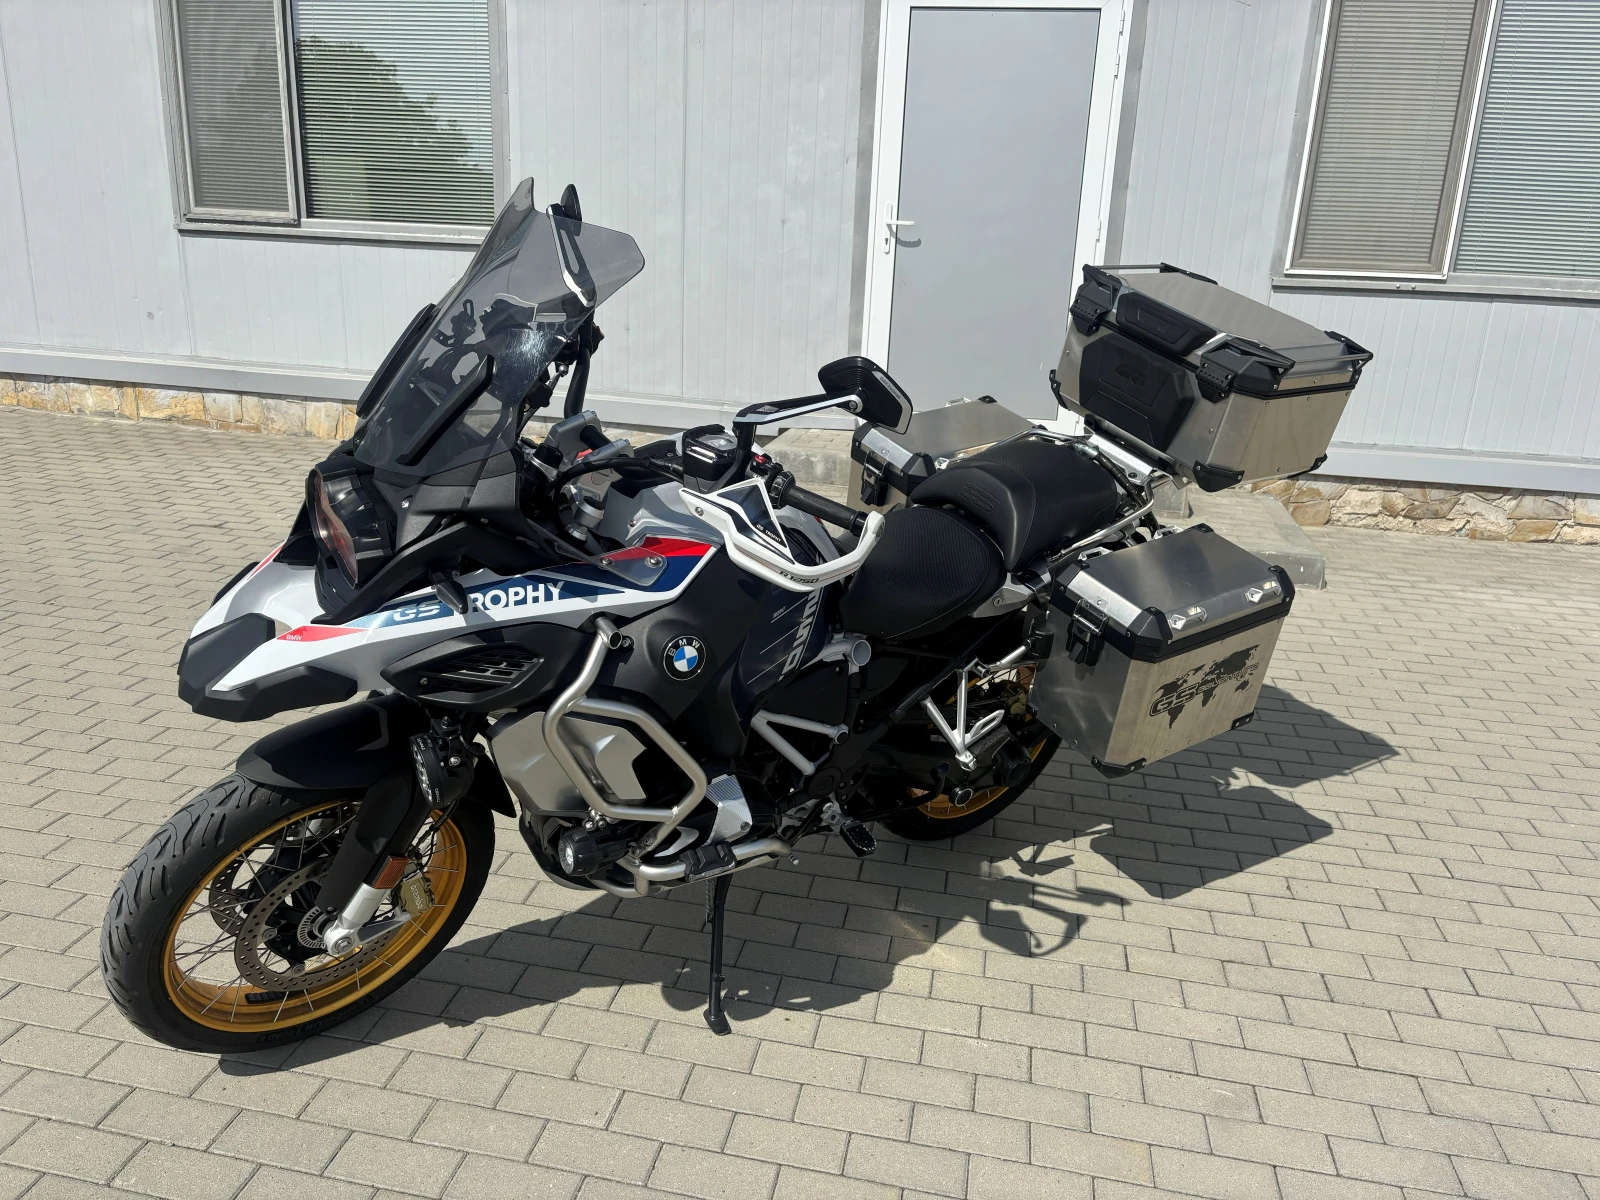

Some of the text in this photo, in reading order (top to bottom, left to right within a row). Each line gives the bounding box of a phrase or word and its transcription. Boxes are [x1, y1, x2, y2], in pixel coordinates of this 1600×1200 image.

[393, 581, 565, 622] GS ROPHY
[667, 638, 701, 657] BMW
[1149, 683, 1199, 717] GS
[410, 882, 424, 909] brembo
